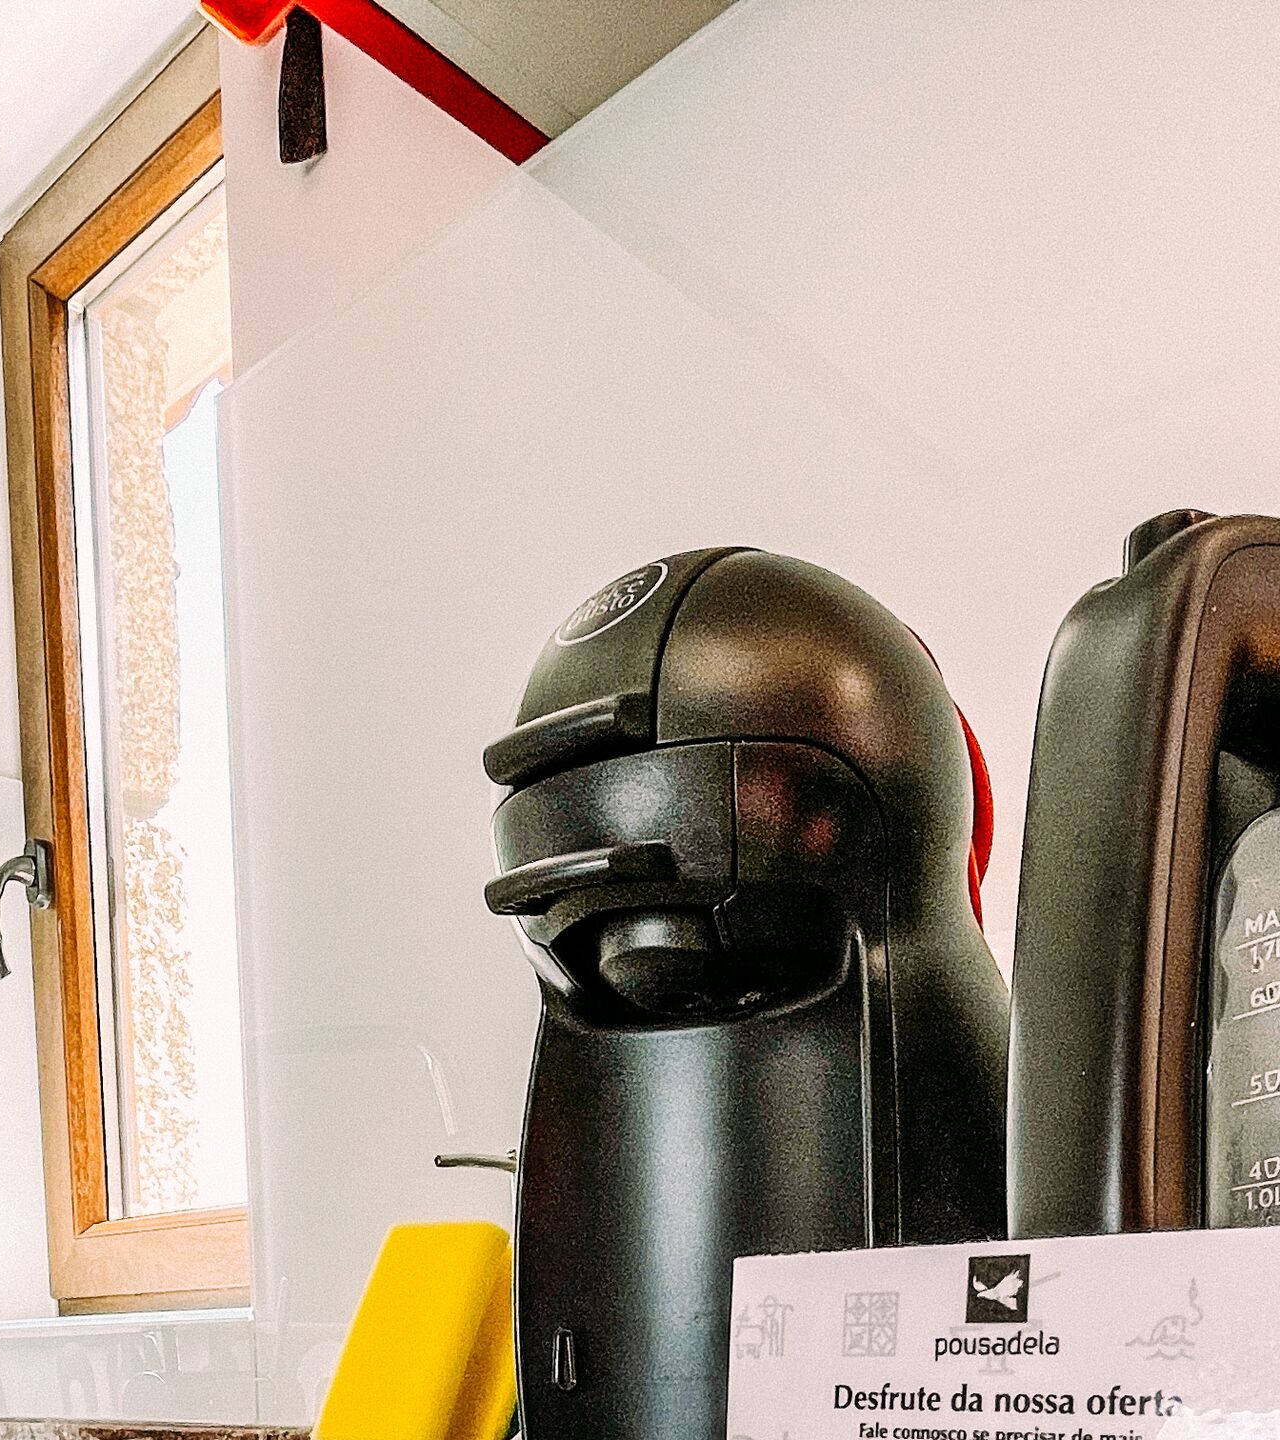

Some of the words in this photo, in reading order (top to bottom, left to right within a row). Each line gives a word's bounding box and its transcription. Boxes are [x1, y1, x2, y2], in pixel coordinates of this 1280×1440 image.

[934, 1331, 1059, 1361] pousadela
[834, 1383, 941, 1411] Desfrute
[951, 1384, 983, 1412] da
[994, 1393, 1075, 1415] nossa
[1087, 1386, 1183, 1417] oferta
[859, 1422, 888, 1439] Fale
